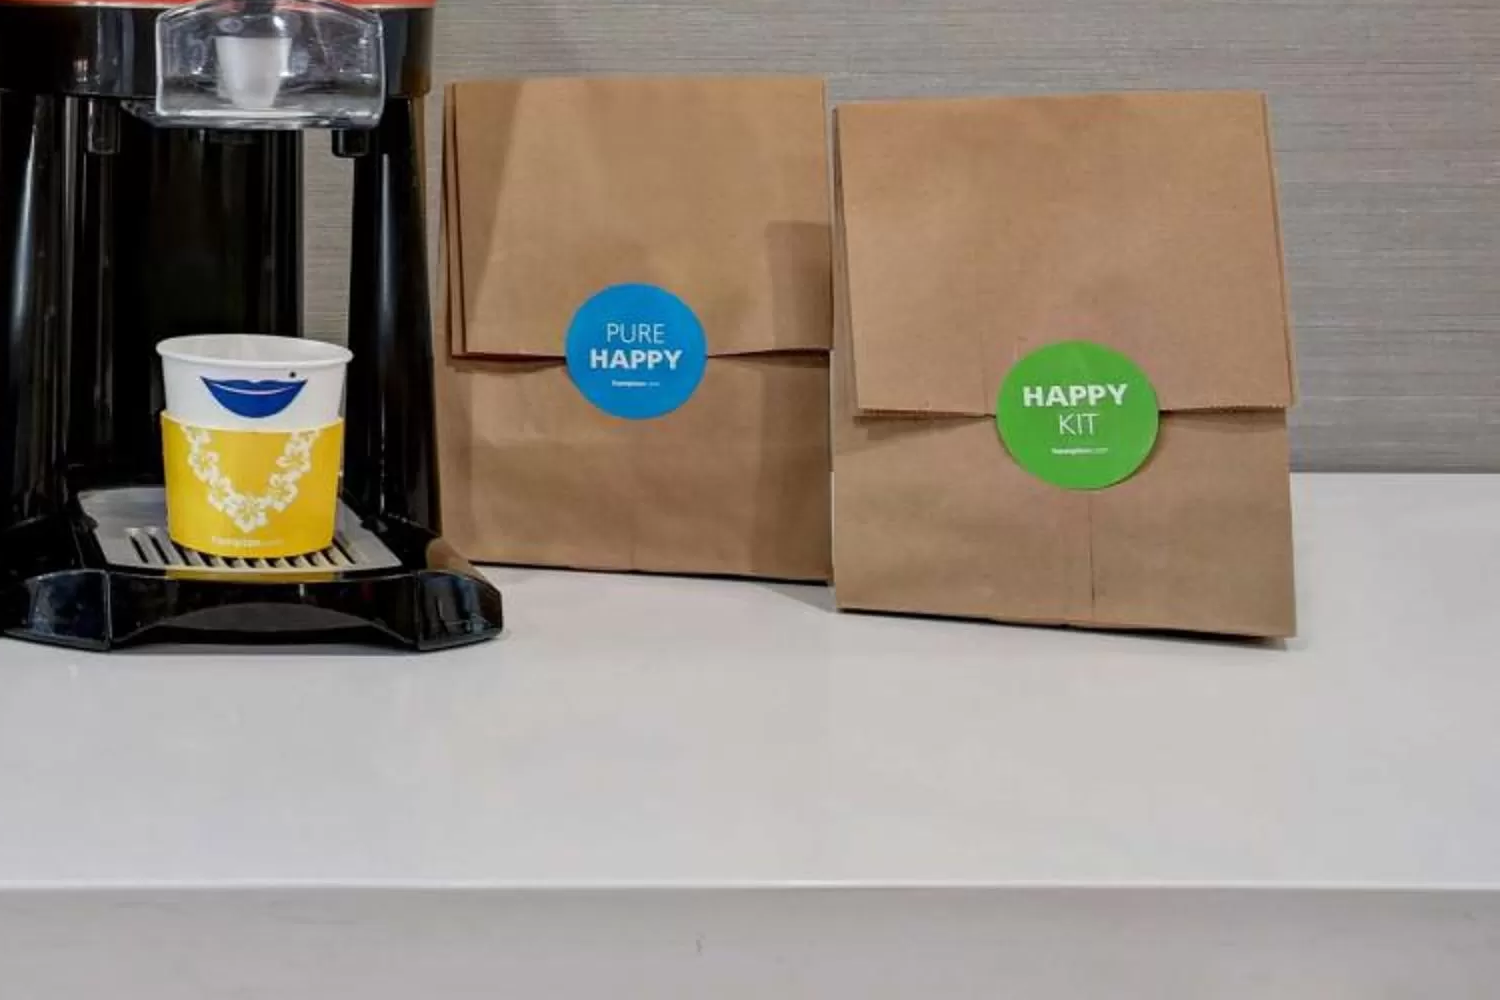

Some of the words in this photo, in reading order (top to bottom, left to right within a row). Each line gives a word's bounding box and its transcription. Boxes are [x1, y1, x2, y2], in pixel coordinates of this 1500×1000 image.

[606, 323, 665, 344] PURE
[590, 348, 683, 370] HAPPY
[1022, 383, 1128, 407] HAPPY
[1058, 412, 1100, 435] KIT
